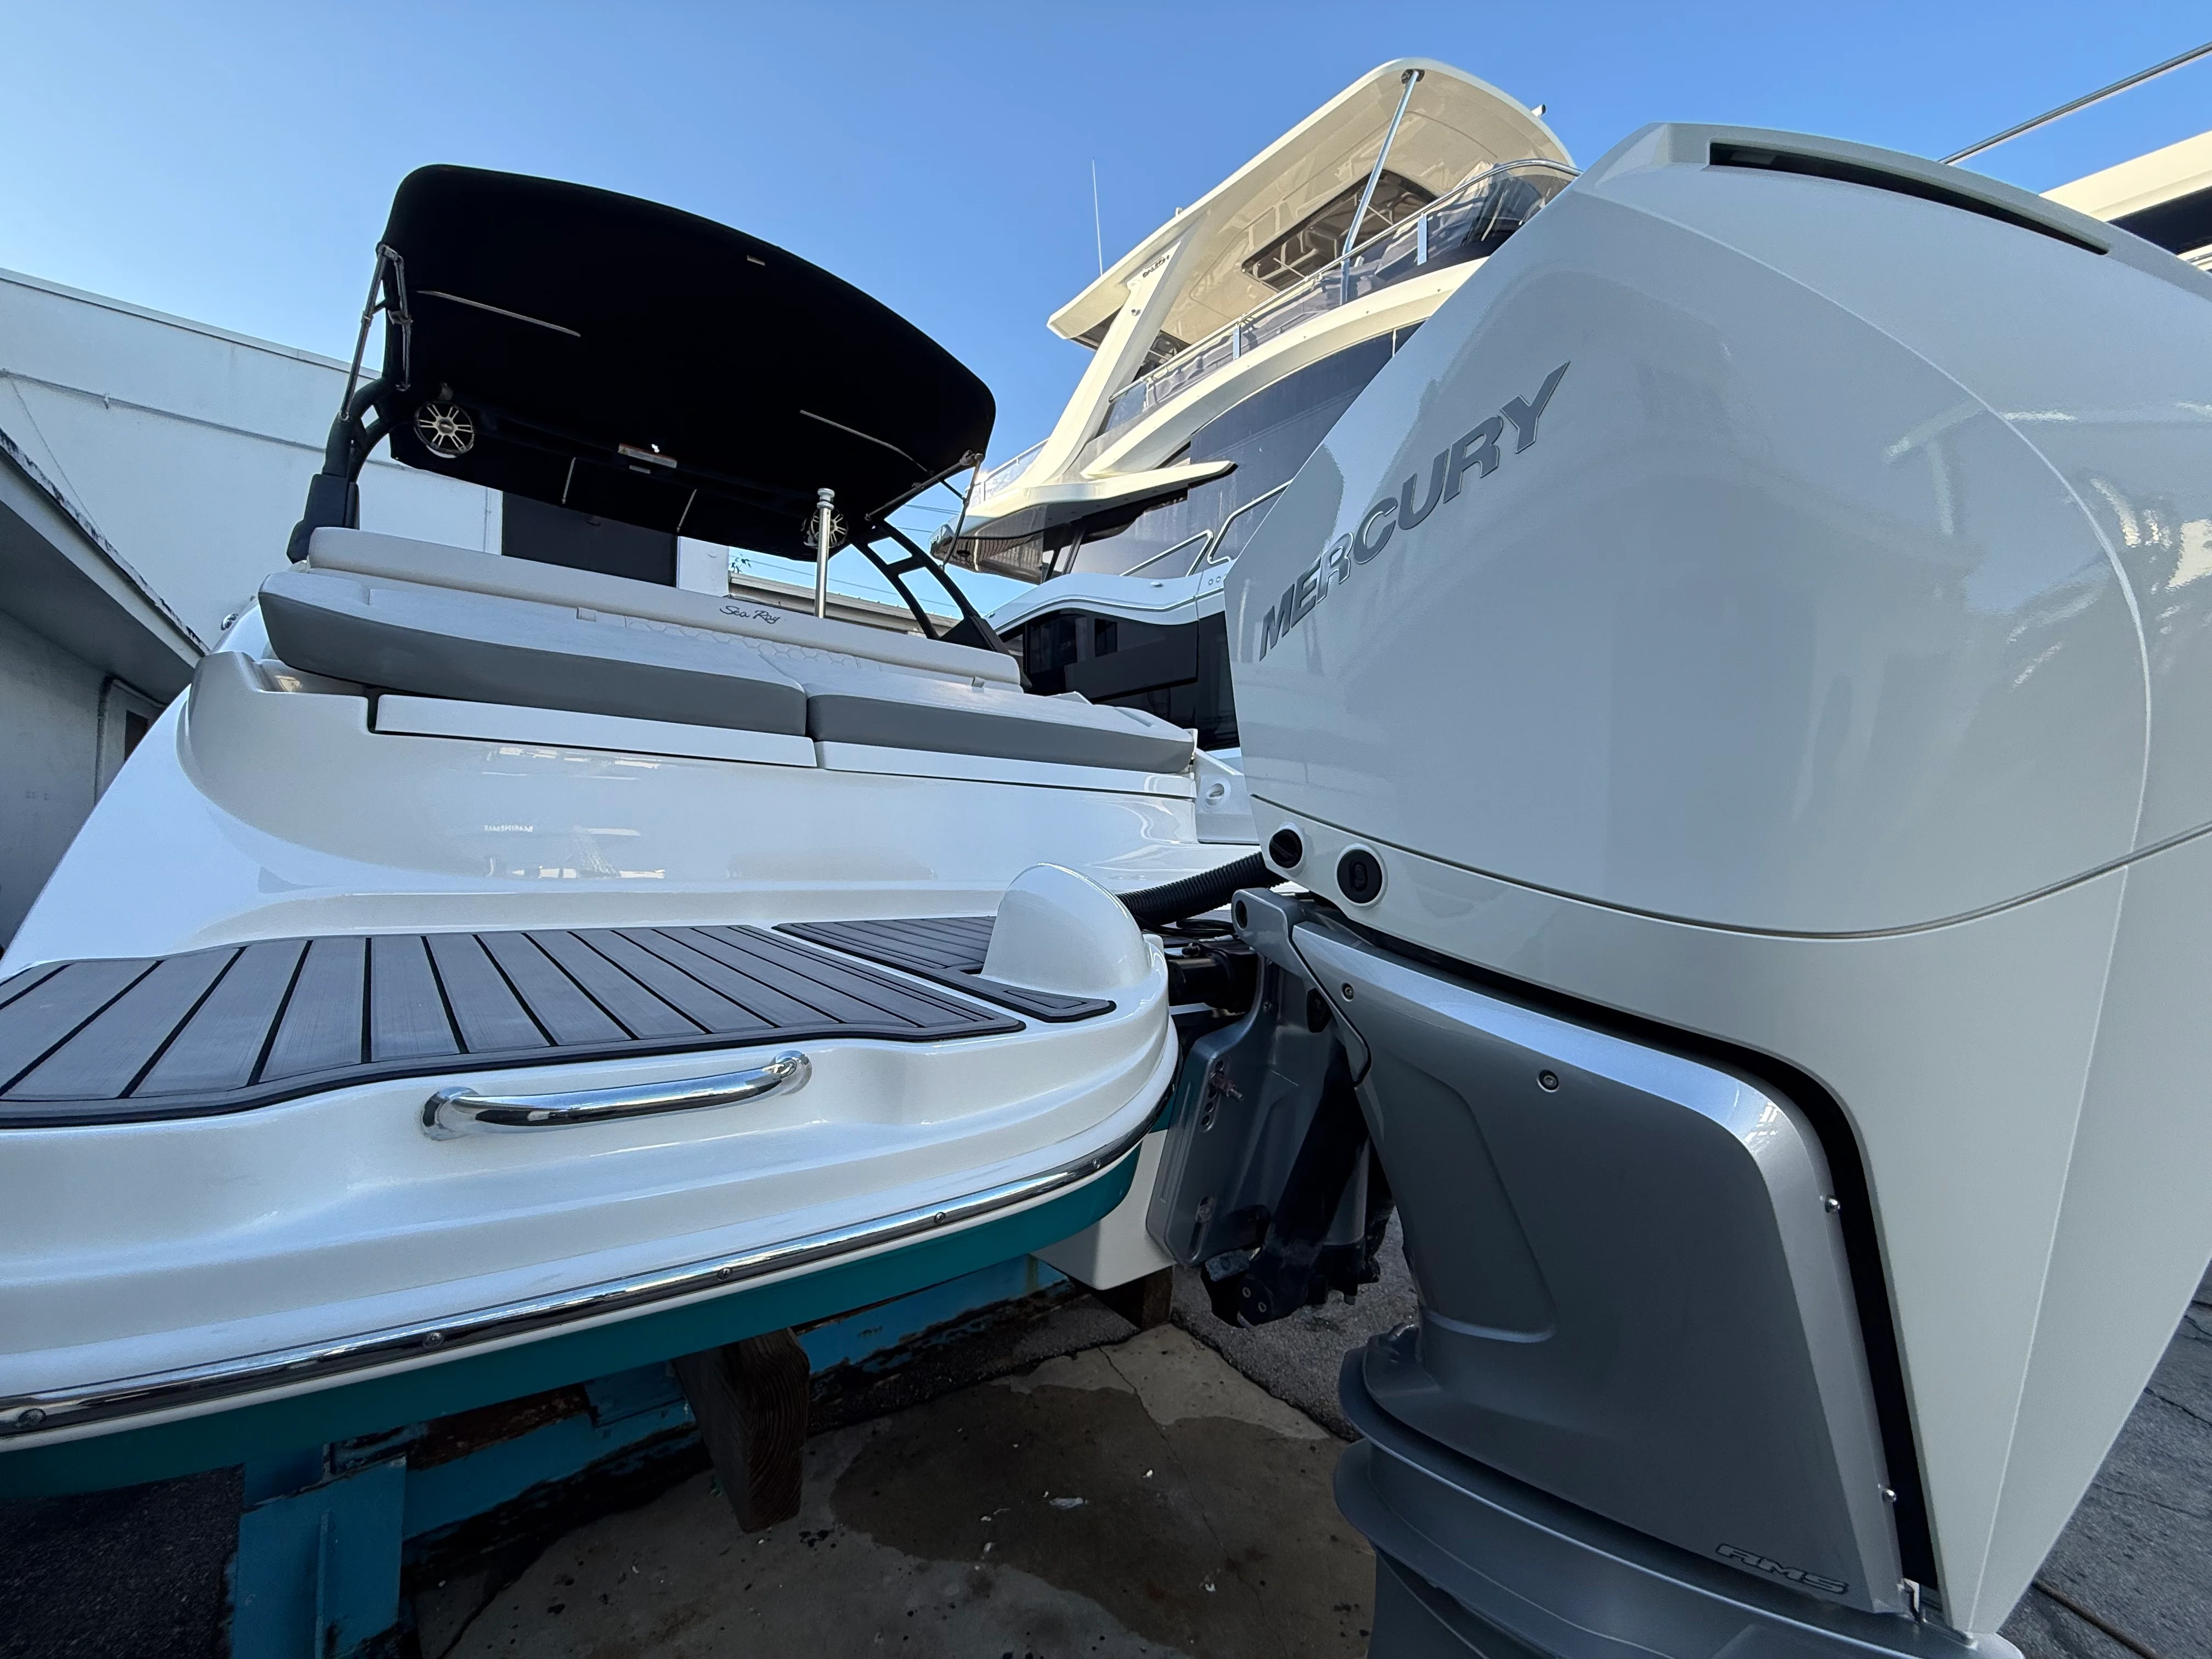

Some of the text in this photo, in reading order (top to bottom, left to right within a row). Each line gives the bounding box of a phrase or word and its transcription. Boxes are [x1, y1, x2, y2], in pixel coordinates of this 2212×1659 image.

[1260, 360, 1570, 661] MERCURY
[719, 606, 781, 624] Sea Ray
[1715, 1543, 1851, 1595] AMS
